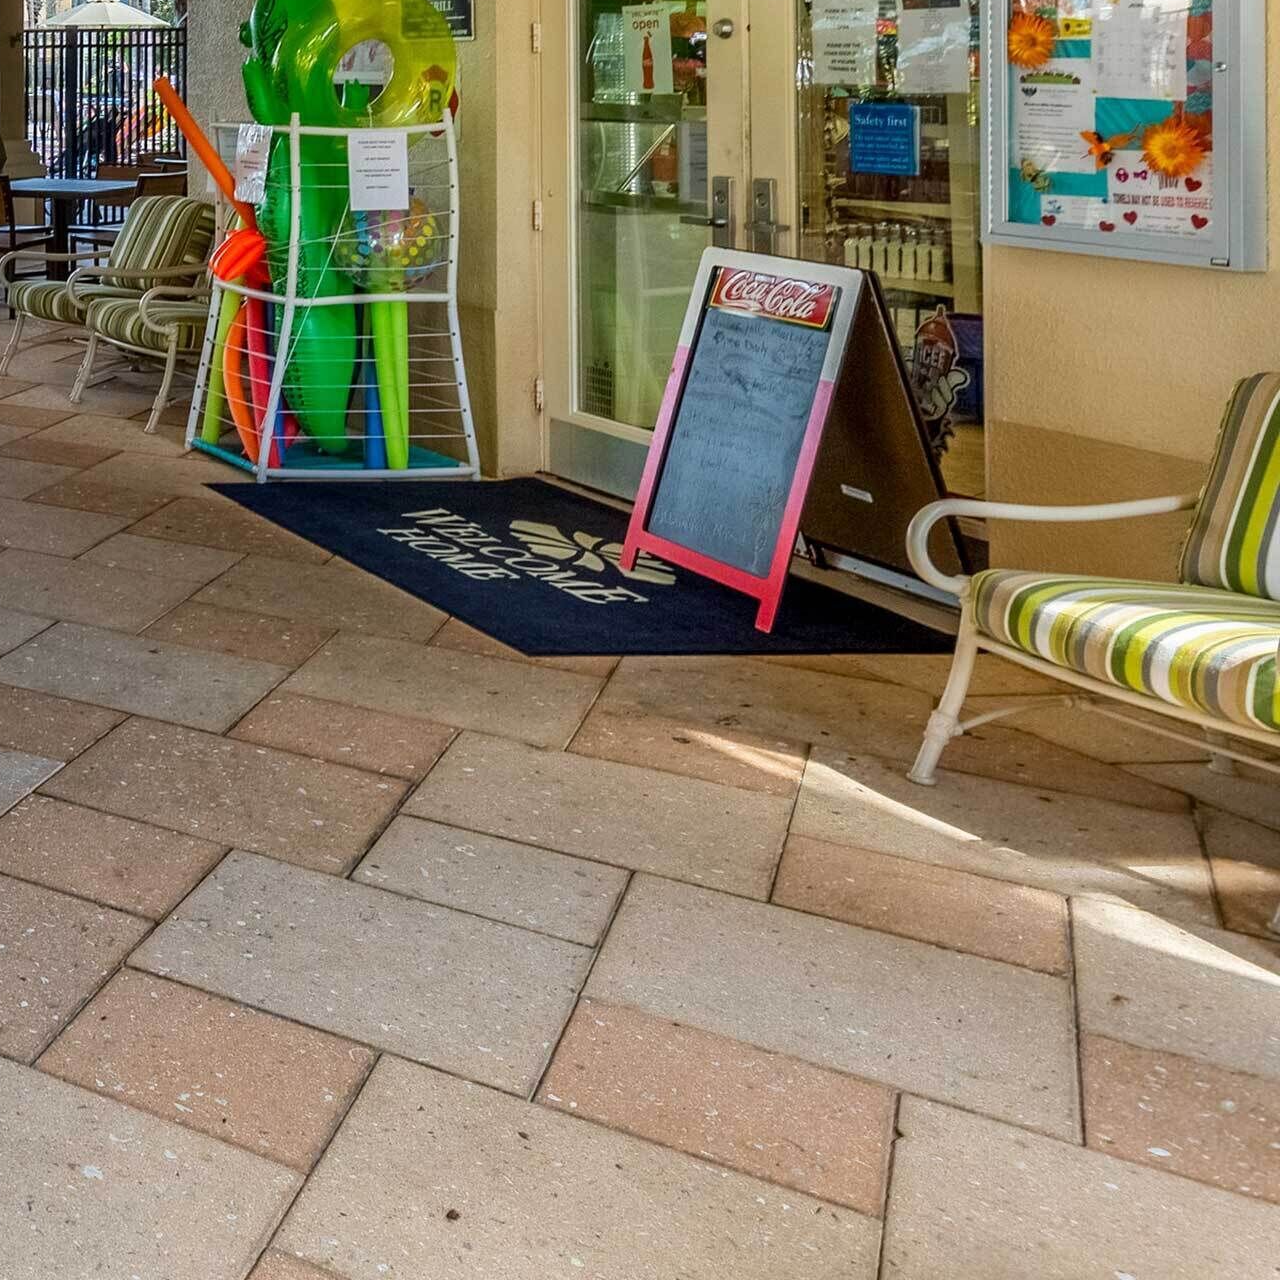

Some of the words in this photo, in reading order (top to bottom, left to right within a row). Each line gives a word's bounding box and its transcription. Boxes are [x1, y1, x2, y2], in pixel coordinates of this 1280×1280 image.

[632, 19, 660, 32] open
[854, 112, 884, 128] Safety
[887, 114, 907, 127] first
[721, 269, 826, 319] Coca-Cola
[376, 527, 521, 581] HOME
[401, 508, 649, 604] WELCOME
